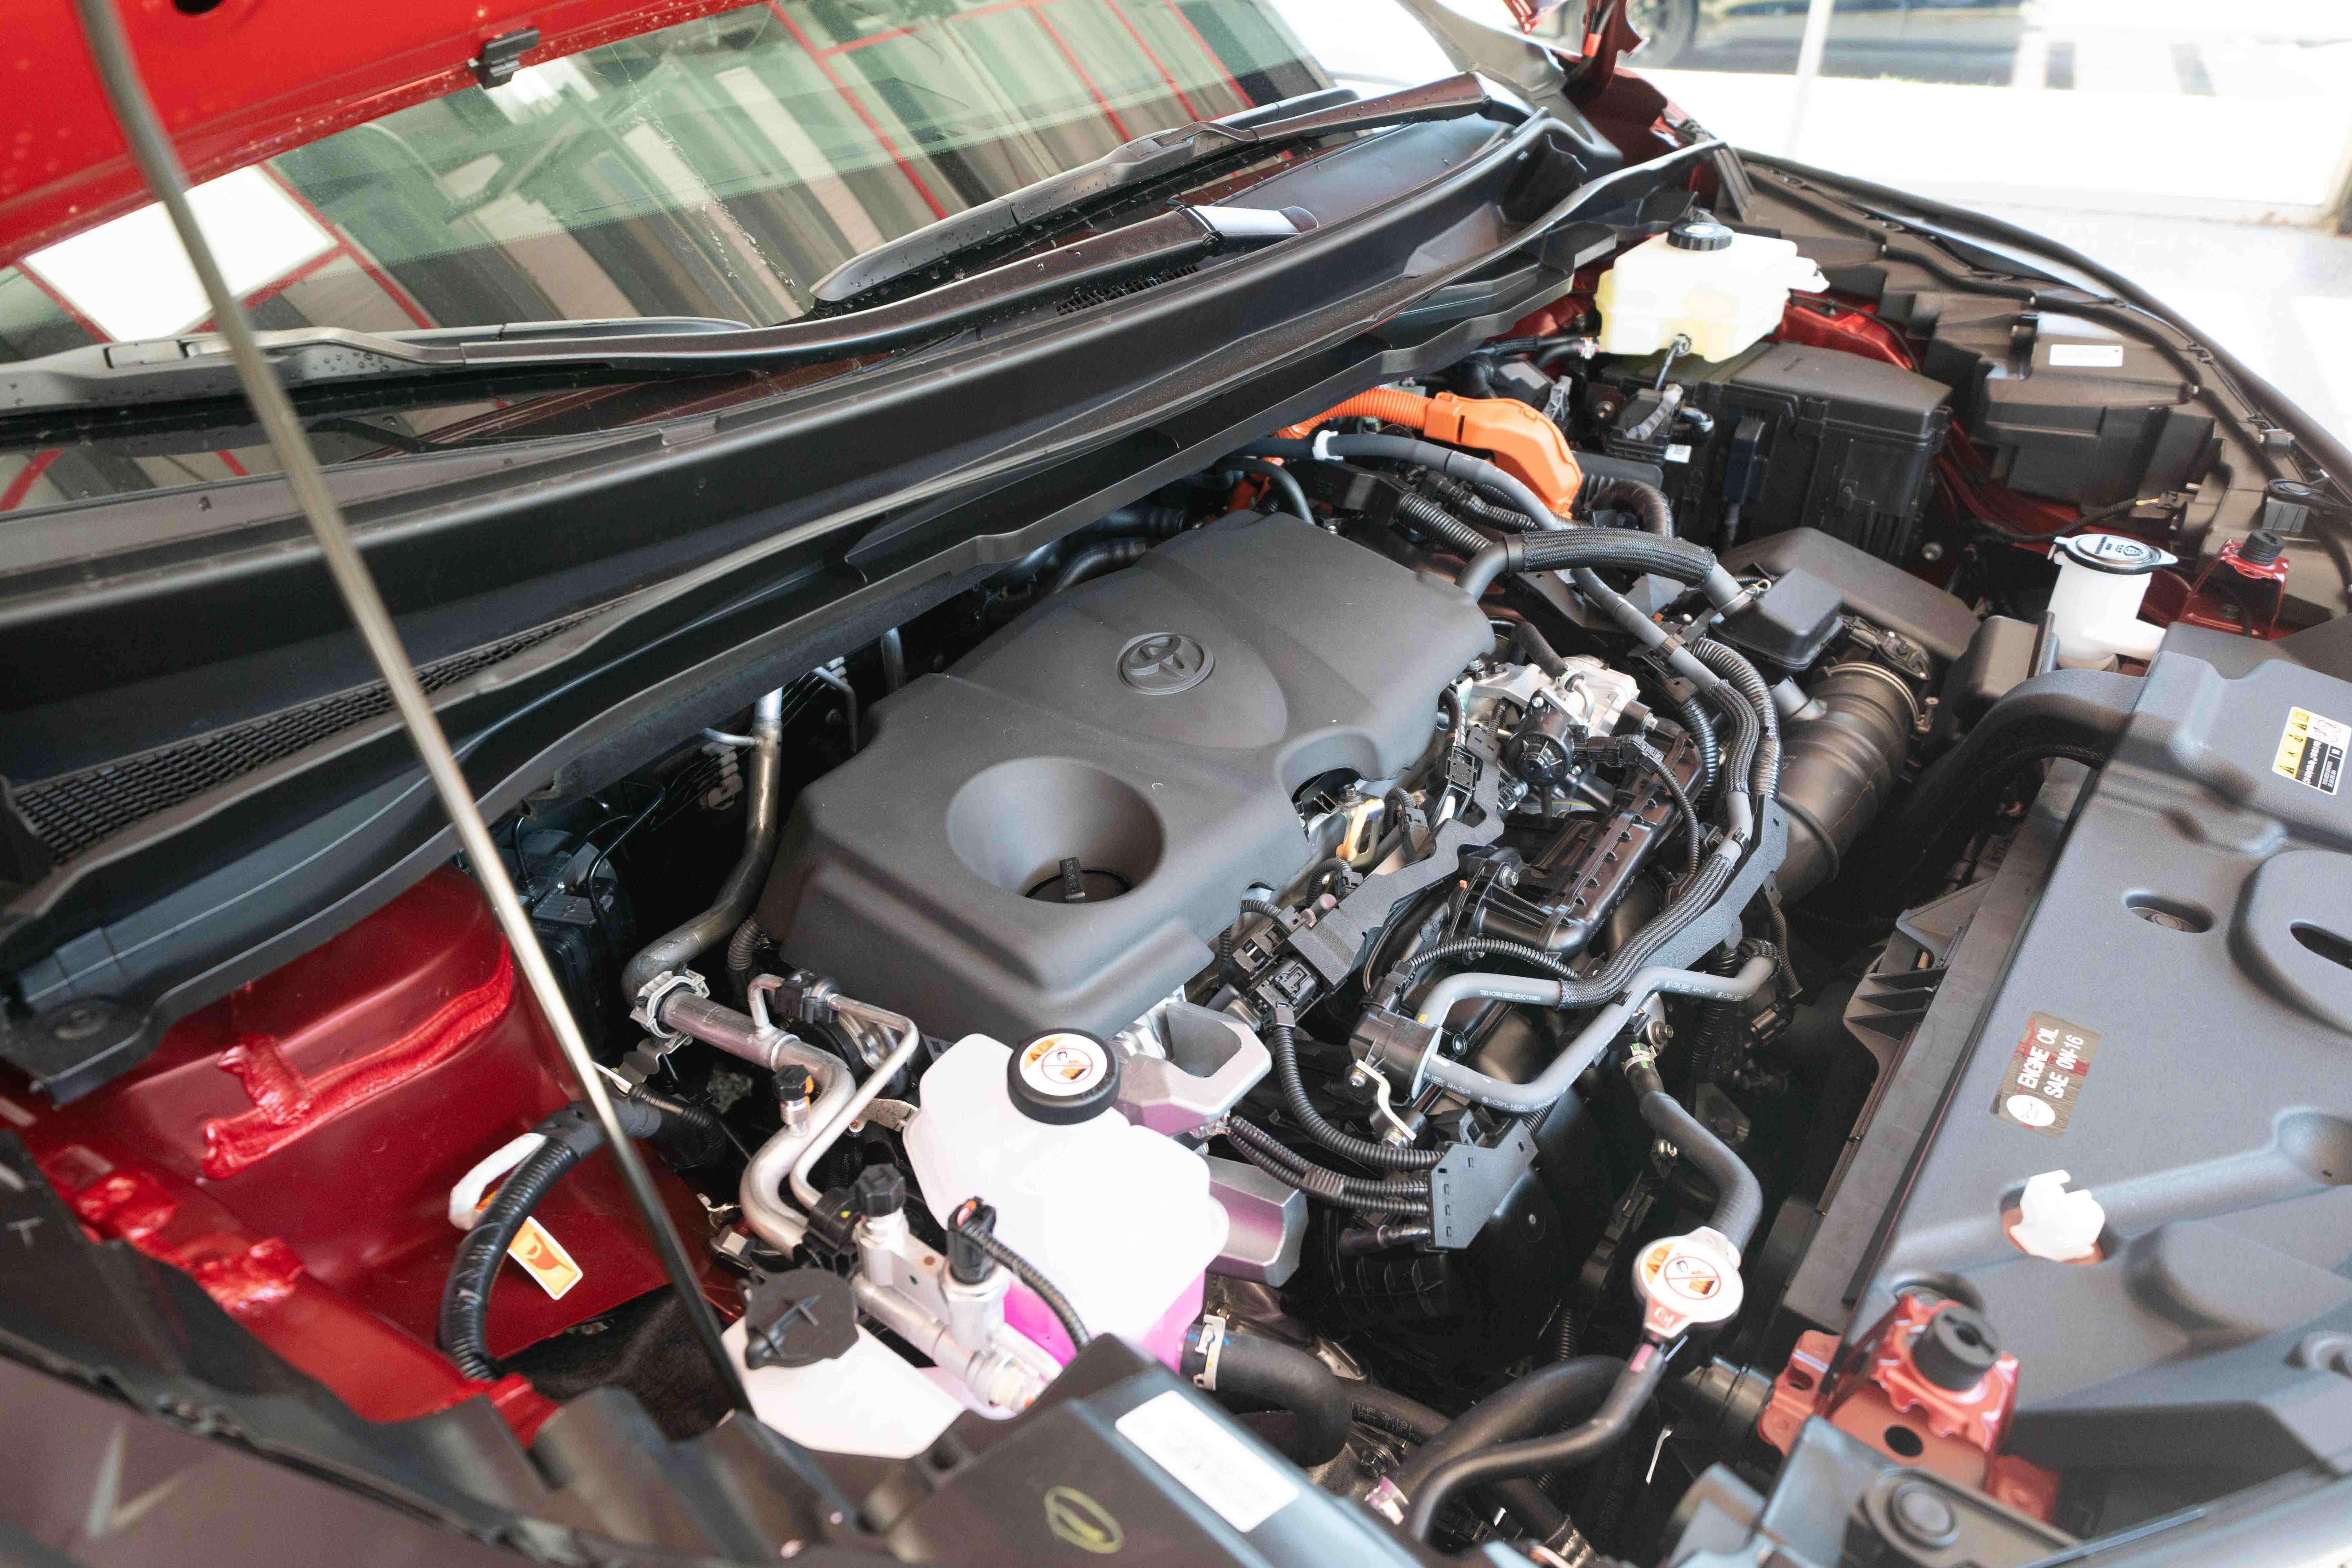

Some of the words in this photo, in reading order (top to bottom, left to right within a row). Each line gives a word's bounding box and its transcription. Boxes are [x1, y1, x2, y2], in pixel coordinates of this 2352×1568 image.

[2017, 1046, 2050, 1089] ENGINE
[2036, 1027, 2059, 1045] OIL
[2055, 1034, 2084, 1070] 0W-16
[2044, 1071, 2069, 1098] SAE
